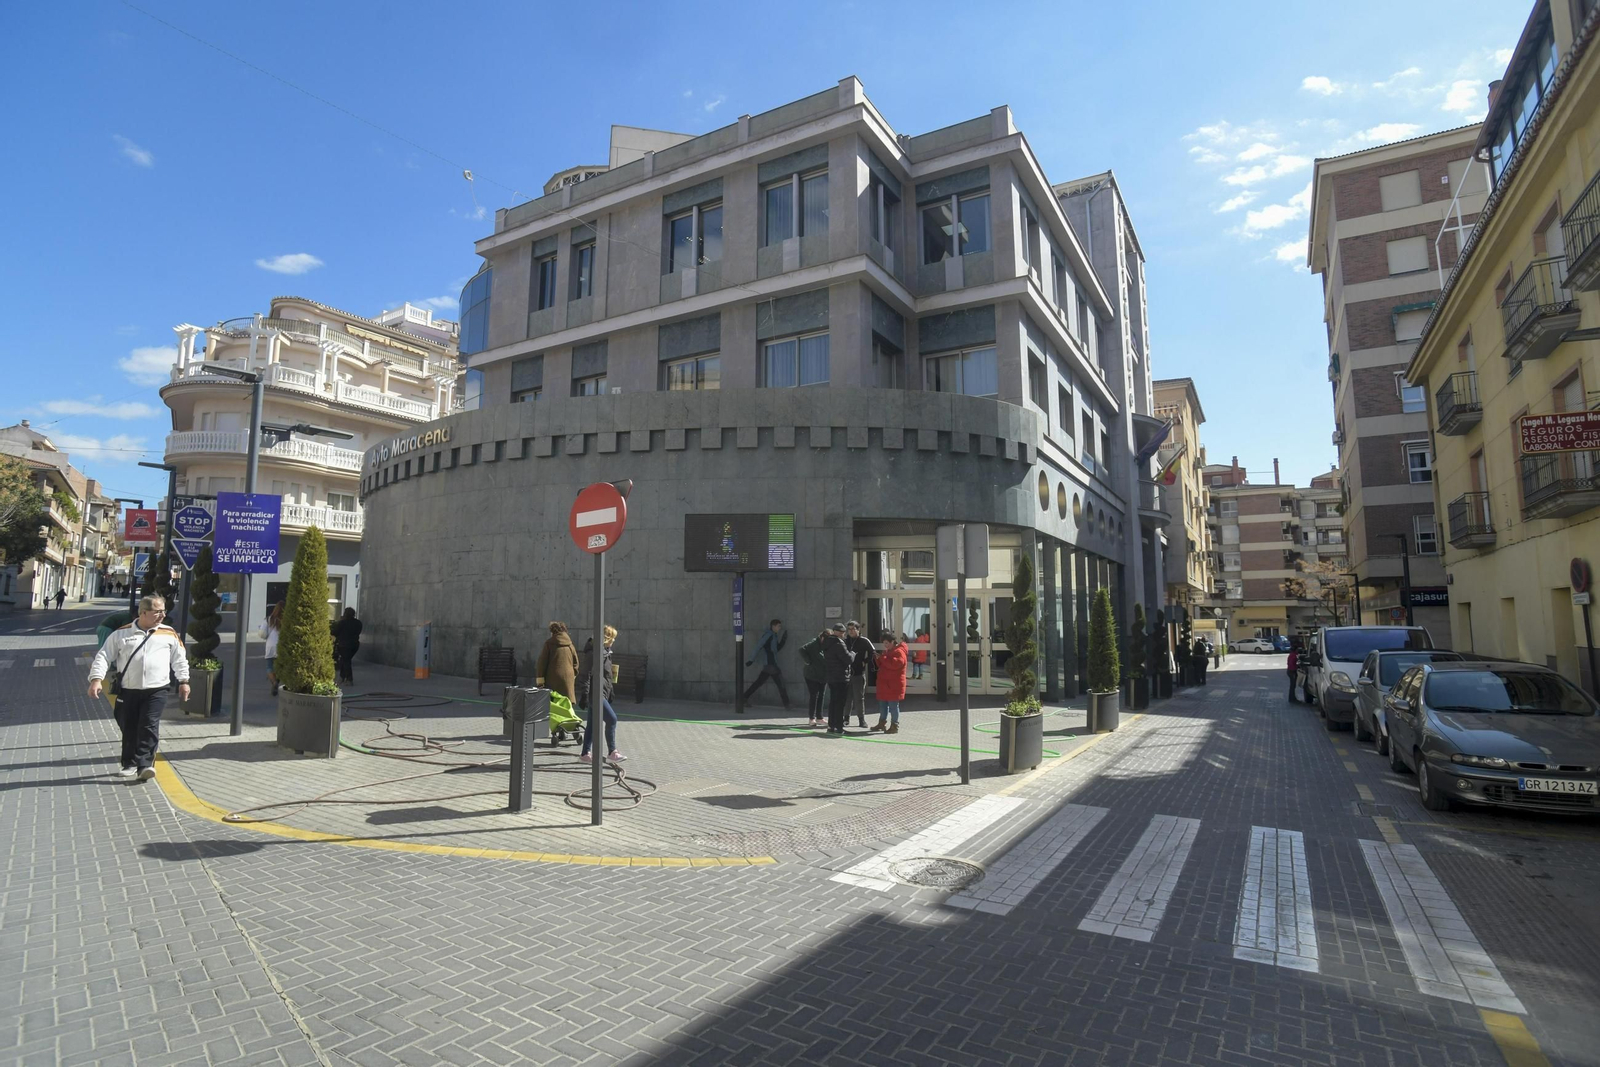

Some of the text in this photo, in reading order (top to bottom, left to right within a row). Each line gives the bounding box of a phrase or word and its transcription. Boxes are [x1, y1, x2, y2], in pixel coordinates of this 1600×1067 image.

[1545, 416, 1555, 425] M.
[1557, 415, 1585, 425] Legaza
[1523, 425, 1582, 436] SEGUROS
[1524, 434, 1575, 443] ASESORIA
[371, 427, 450, 469] Ayto Maracena
[1524, 442, 1563, 451] LABORAL
[179, 517, 210, 525] STOP
[235, 539, 259, 548] #ESTE
[216, 548, 276, 556] AYUNTAMIENTO
[233, 555, 273, 564] IMPLICA
[1410, 592, 1448, 602] cajasur
[1525, 779, 1594, 793] GR 1213 AZ
